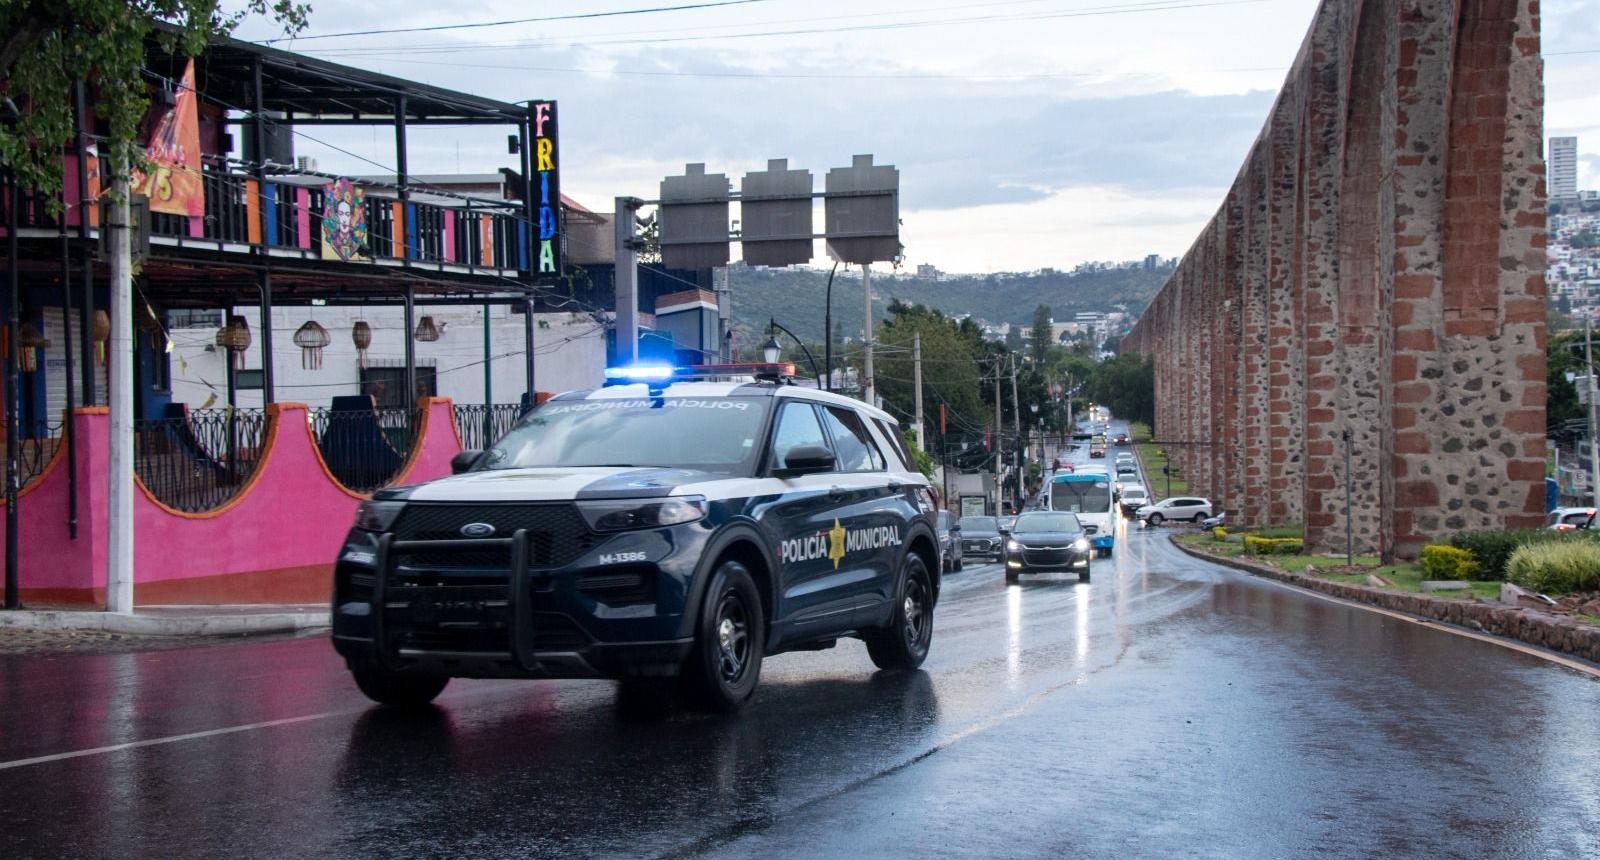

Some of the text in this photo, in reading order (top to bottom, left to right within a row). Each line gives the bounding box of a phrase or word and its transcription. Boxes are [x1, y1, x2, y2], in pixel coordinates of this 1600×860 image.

[535, 103, 556, 272] FRIDA
[599, 551, 646, 565] M-1386
[781, 525, 902, 563] POLICÍA MUNICIPAL
